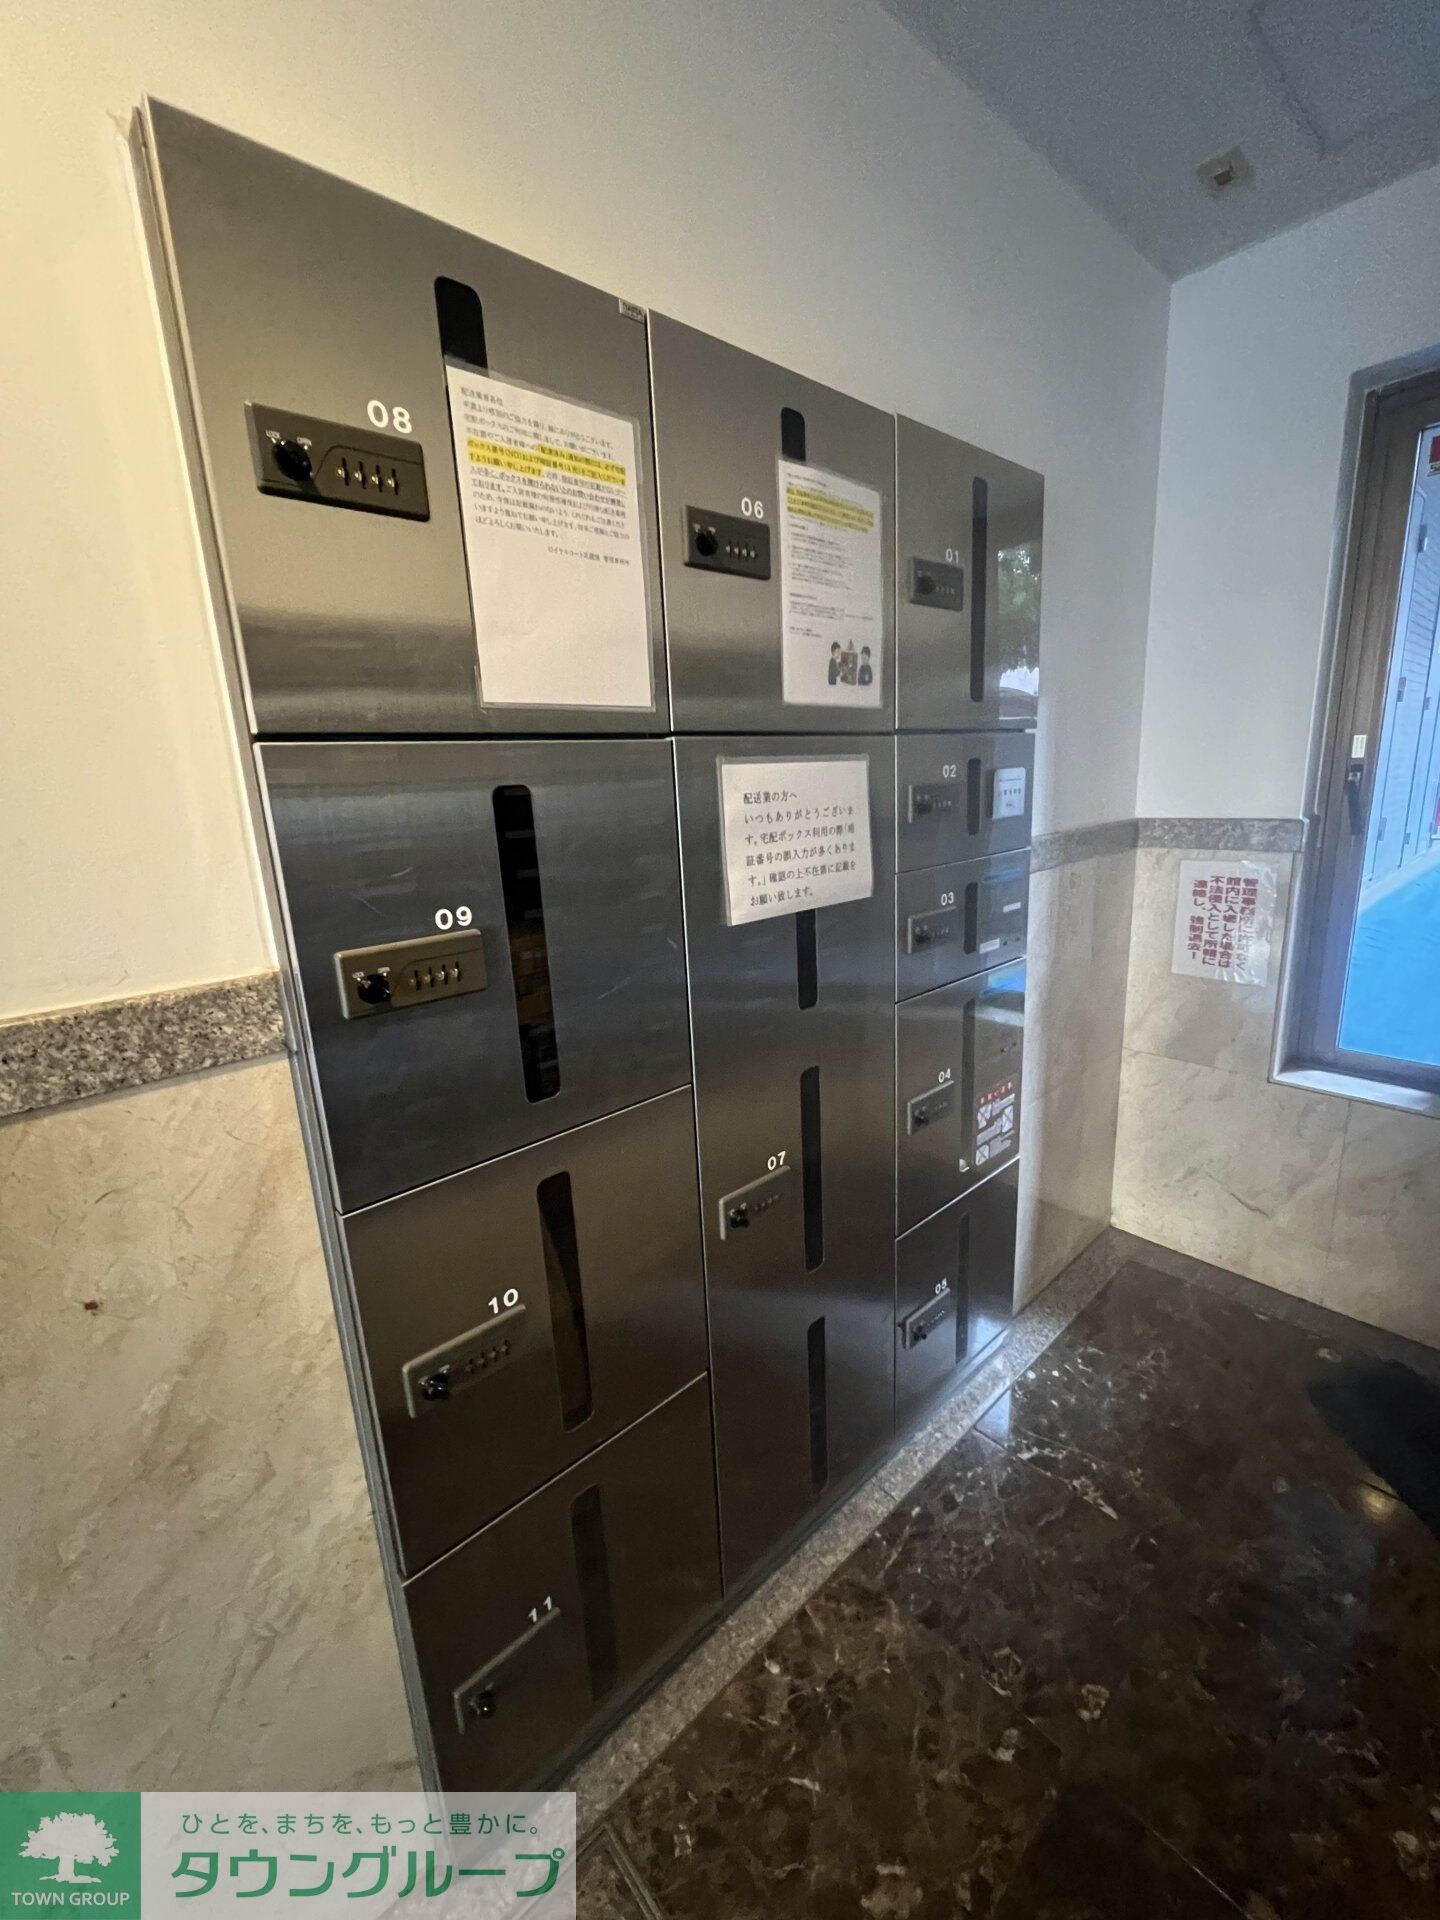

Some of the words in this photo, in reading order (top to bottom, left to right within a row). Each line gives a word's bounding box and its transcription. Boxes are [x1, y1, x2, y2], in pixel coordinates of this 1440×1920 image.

[367, 400, 412, 433] 08
[741, 497, 764, 519] 06
[945, 548, 959, 564] 01
[942, 764, 957, 778] 02
[744, 805, 854, 824] いつもありがとうございま
[940, 892, 955, 906] 03
[434, 905, 473, 930] 09
[938, 1068, 951, 1083] 04
[767, 1151, 786, 1171] 07
[934, 1278, 948, 1294] 05
[488, 1288, 519, 1314] 10
[528, 1595, 552, 1623] 11
